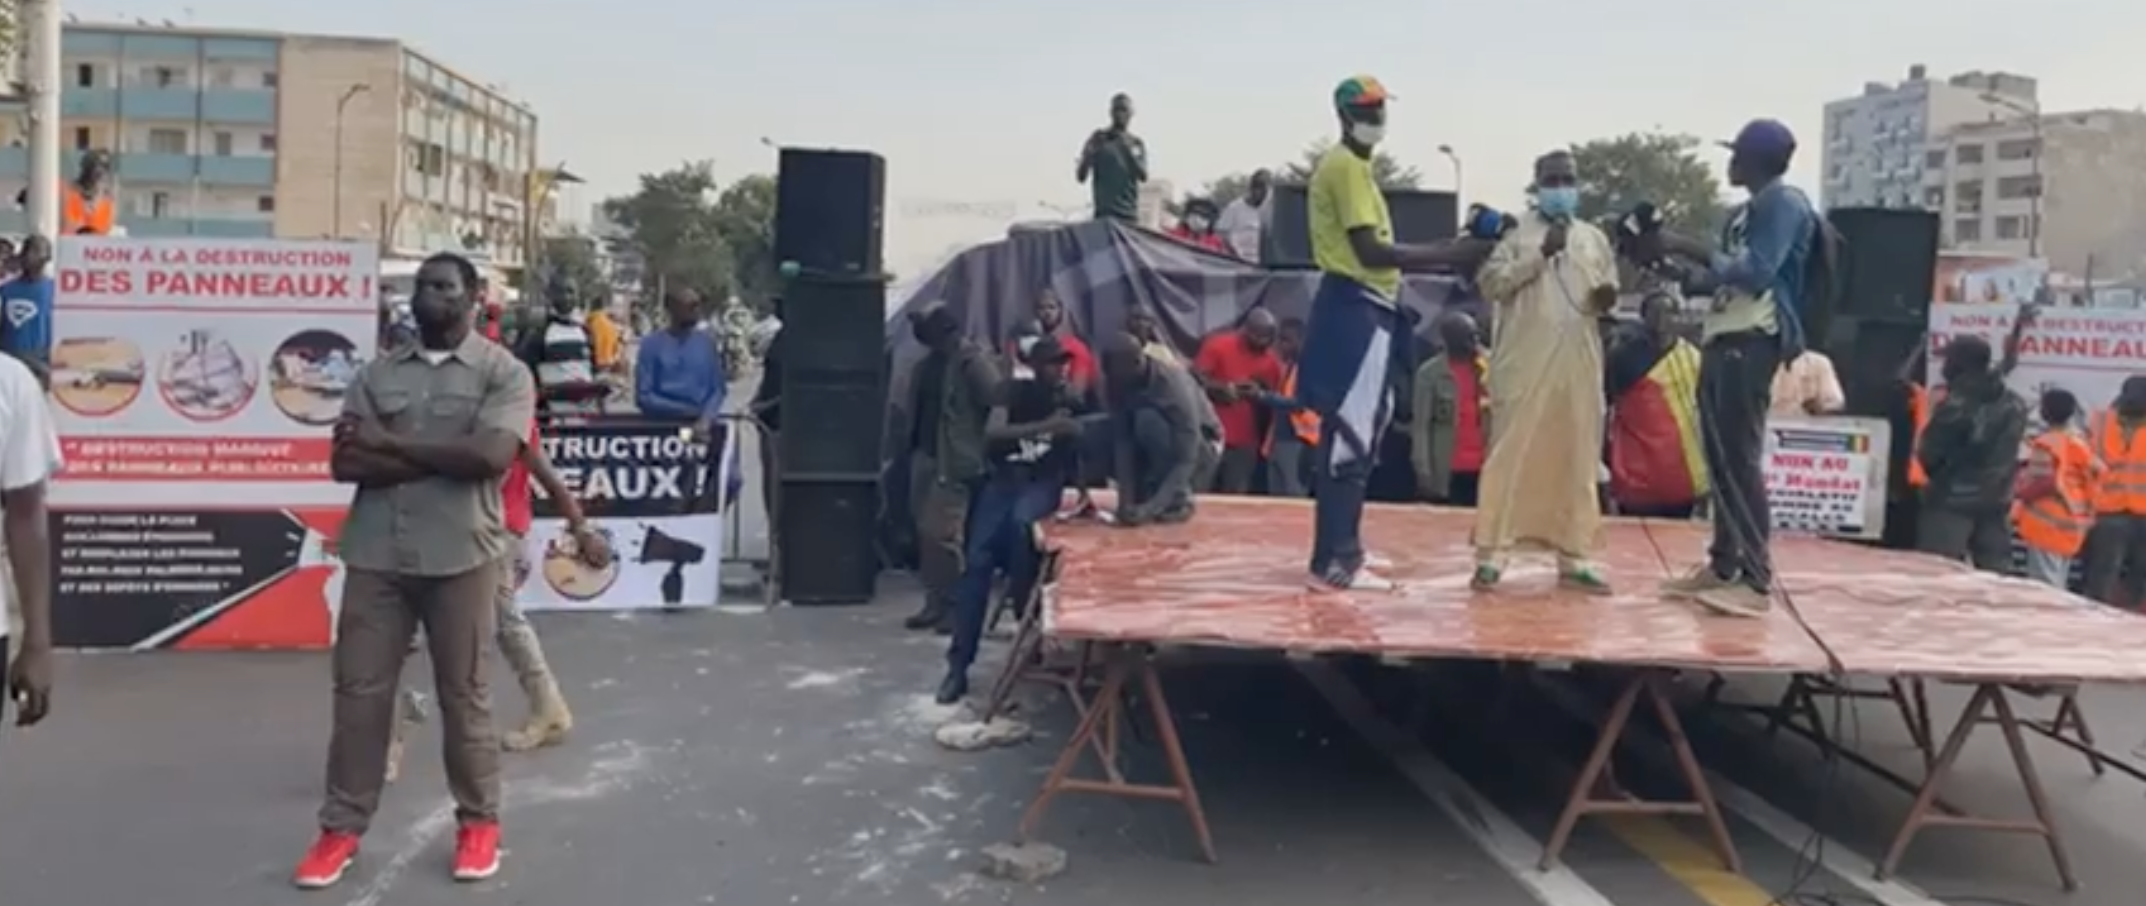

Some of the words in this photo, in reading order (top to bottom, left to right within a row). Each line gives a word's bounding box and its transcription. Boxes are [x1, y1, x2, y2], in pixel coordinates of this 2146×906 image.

[84, 247, 131, 262] NON
[161, 249, 188, 263] LA
[195, 249, 351, 267] DESTRUCTION
[60, 269, 132, 294] DES
[146, 270, 349, 298] PANNEAUX
[361, 275, 371, 298] !
[694, 466, 707, 497] !
